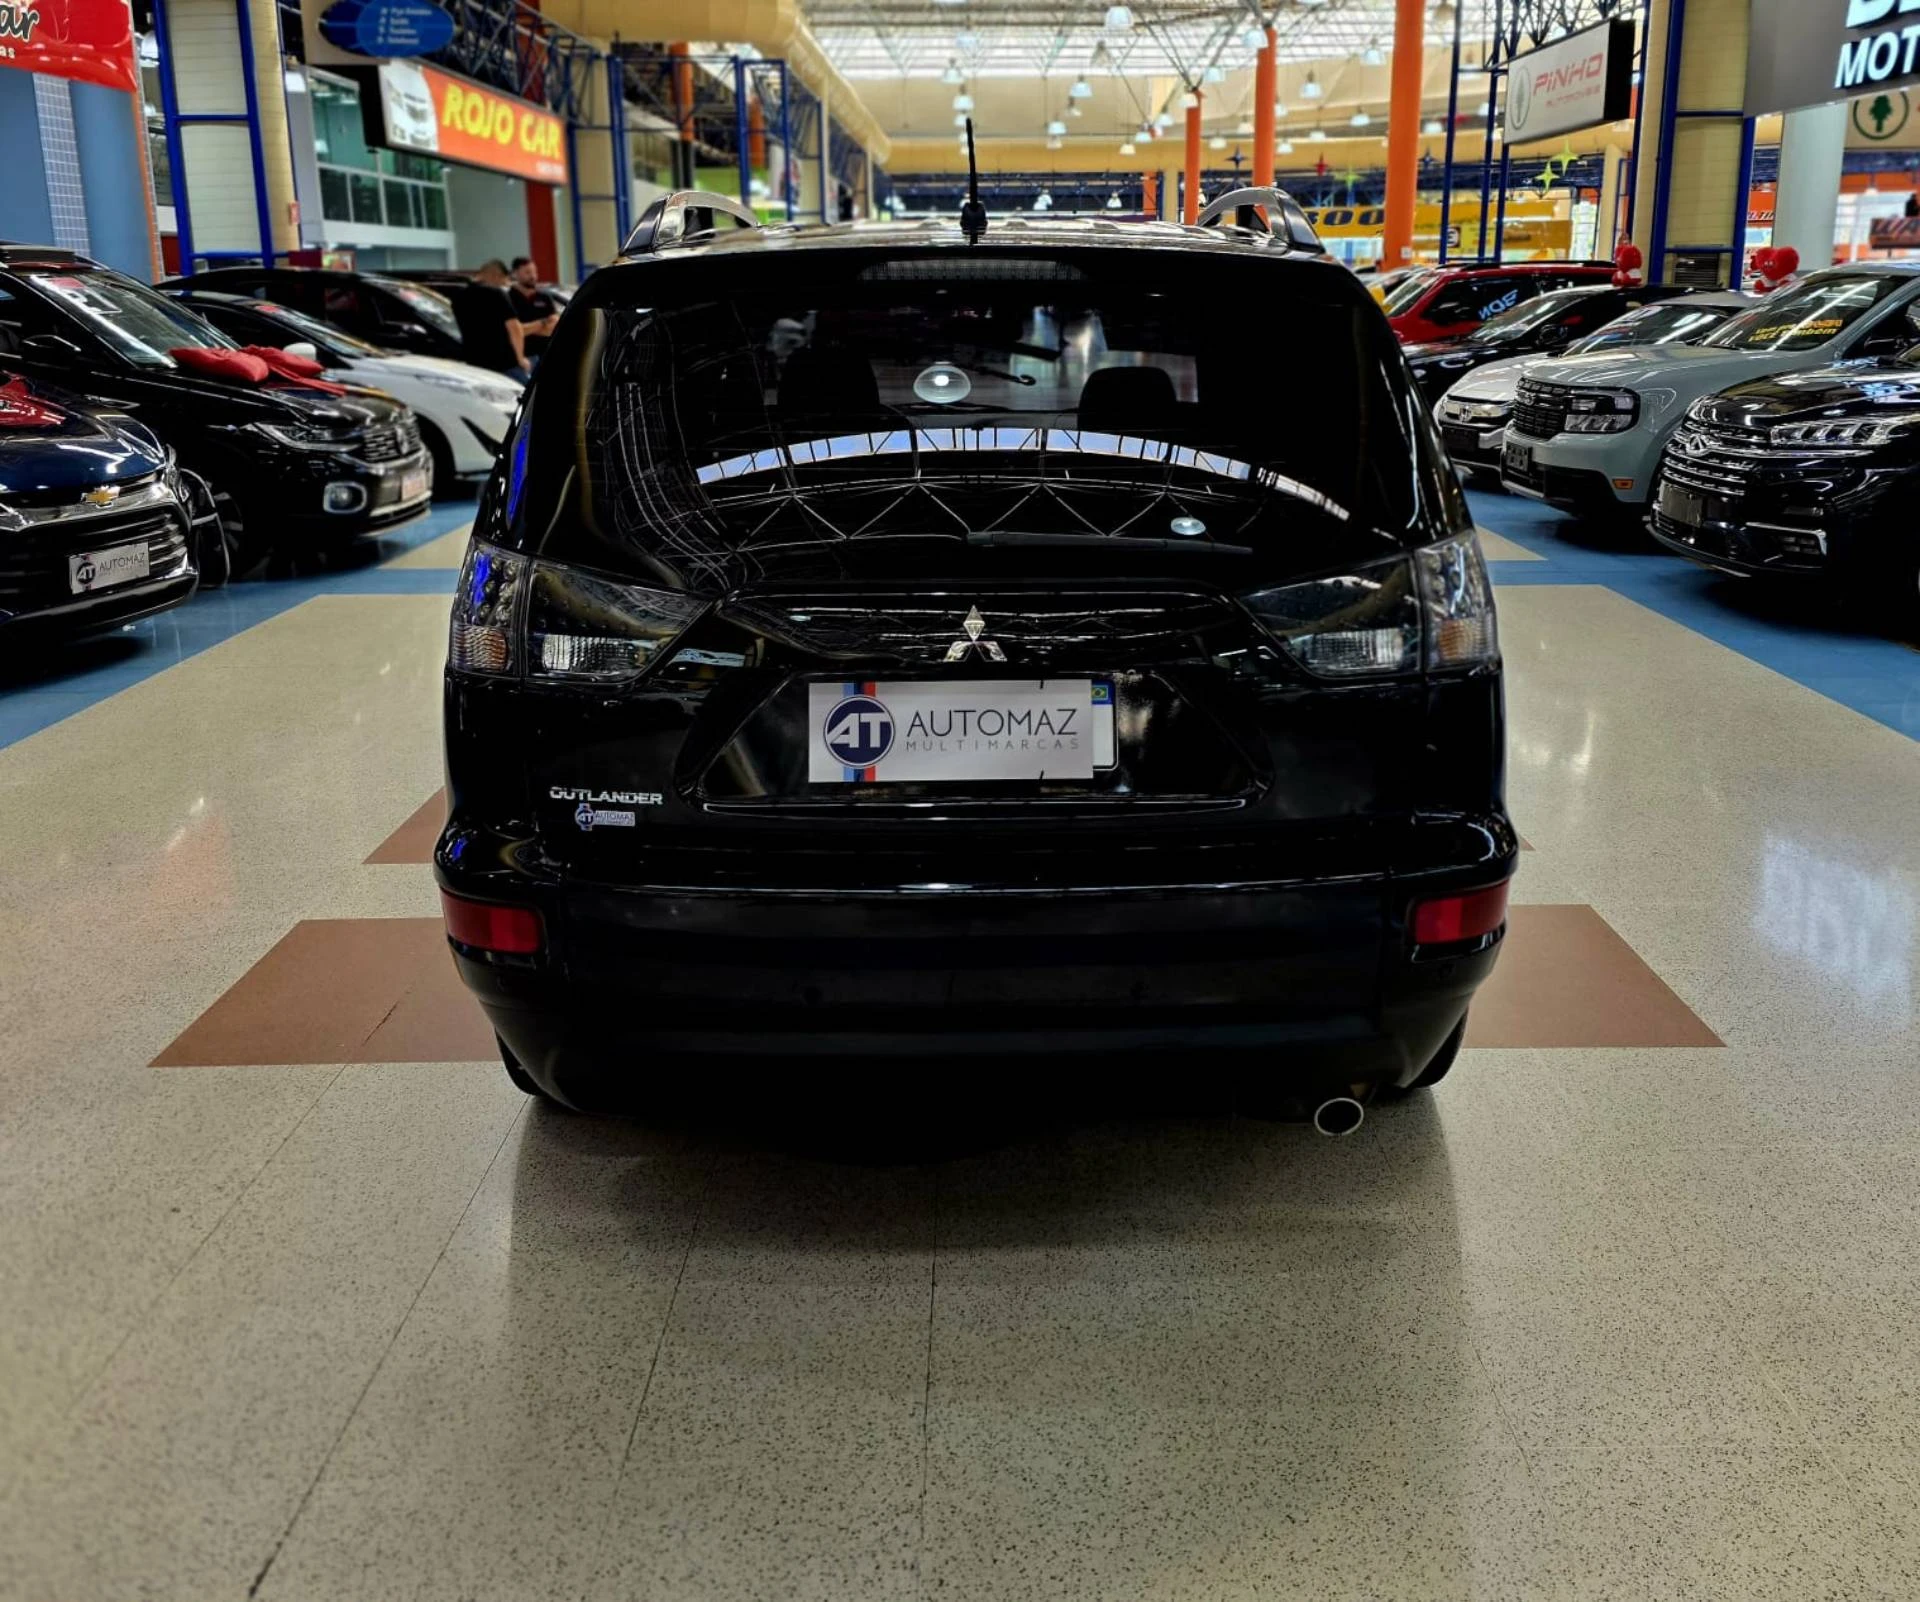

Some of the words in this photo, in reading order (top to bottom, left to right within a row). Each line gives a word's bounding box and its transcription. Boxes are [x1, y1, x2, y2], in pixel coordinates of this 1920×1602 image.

[442, 82, 515, 146] ROJO
[519, 112, 562, 160] CAR
[99, 552, 145, 572] AUTOMAZ
[906, 708, 1078, 737] AUTOMAZ
[906, 738, 1080, 752] MULTIMARCAS
[549, 786, 664, 805] OUTLANDER
